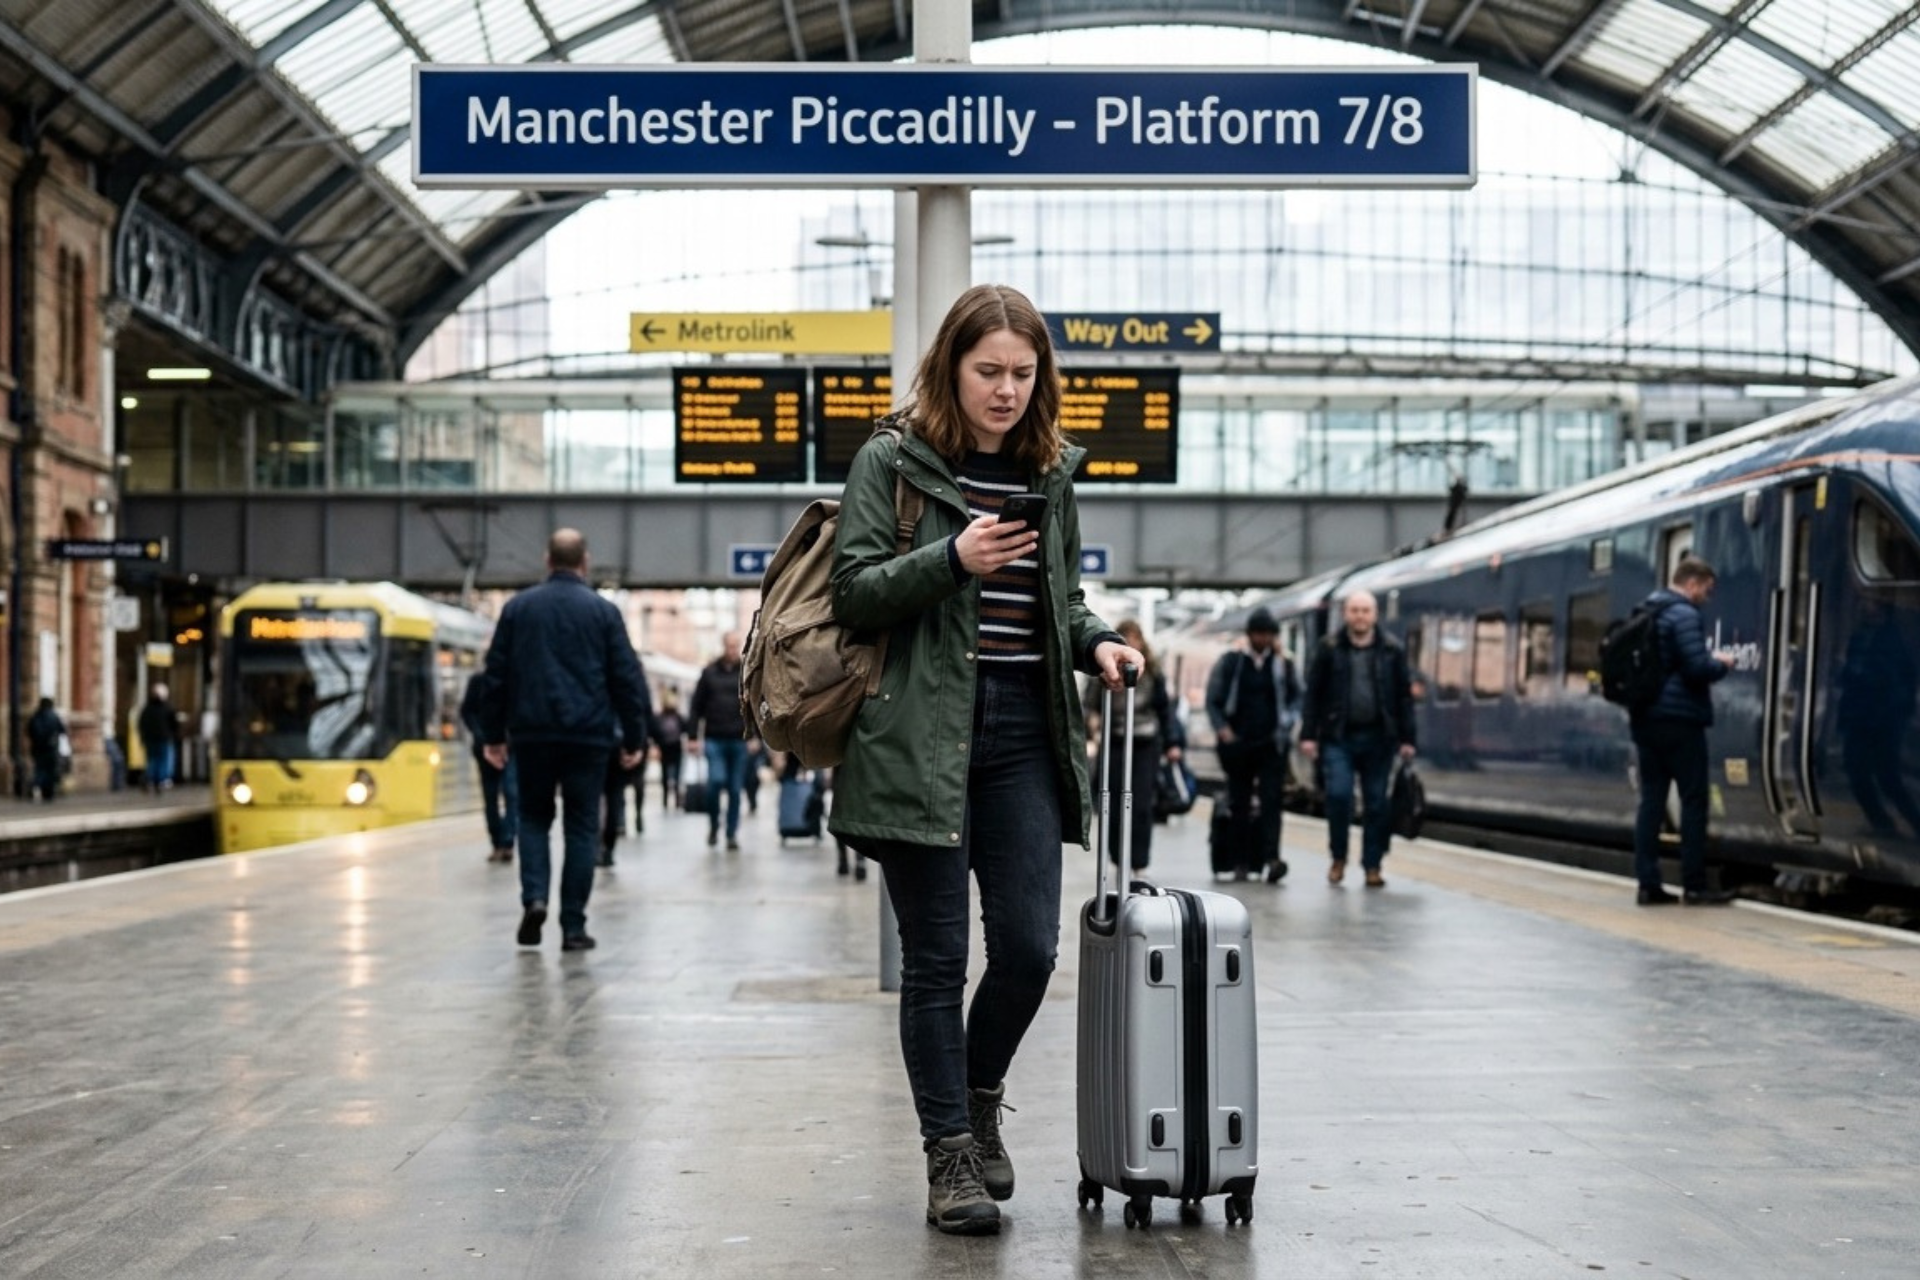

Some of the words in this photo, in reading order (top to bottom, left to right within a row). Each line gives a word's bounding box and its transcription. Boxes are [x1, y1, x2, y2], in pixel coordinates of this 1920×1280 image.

[467, 95, 774, 144] Manchester
[792, 95, 1036, 156] Piccadilly
[1053, 120, 1076, 129] -
[1096, 95, 1320, 145] Platform
[1339, 94, 1423, 150] 7/8
[677, 319, 795, 342] Metrolink
[1063, 318, 1118, 349] Way
[1122, 317, 1169, 343] Out
